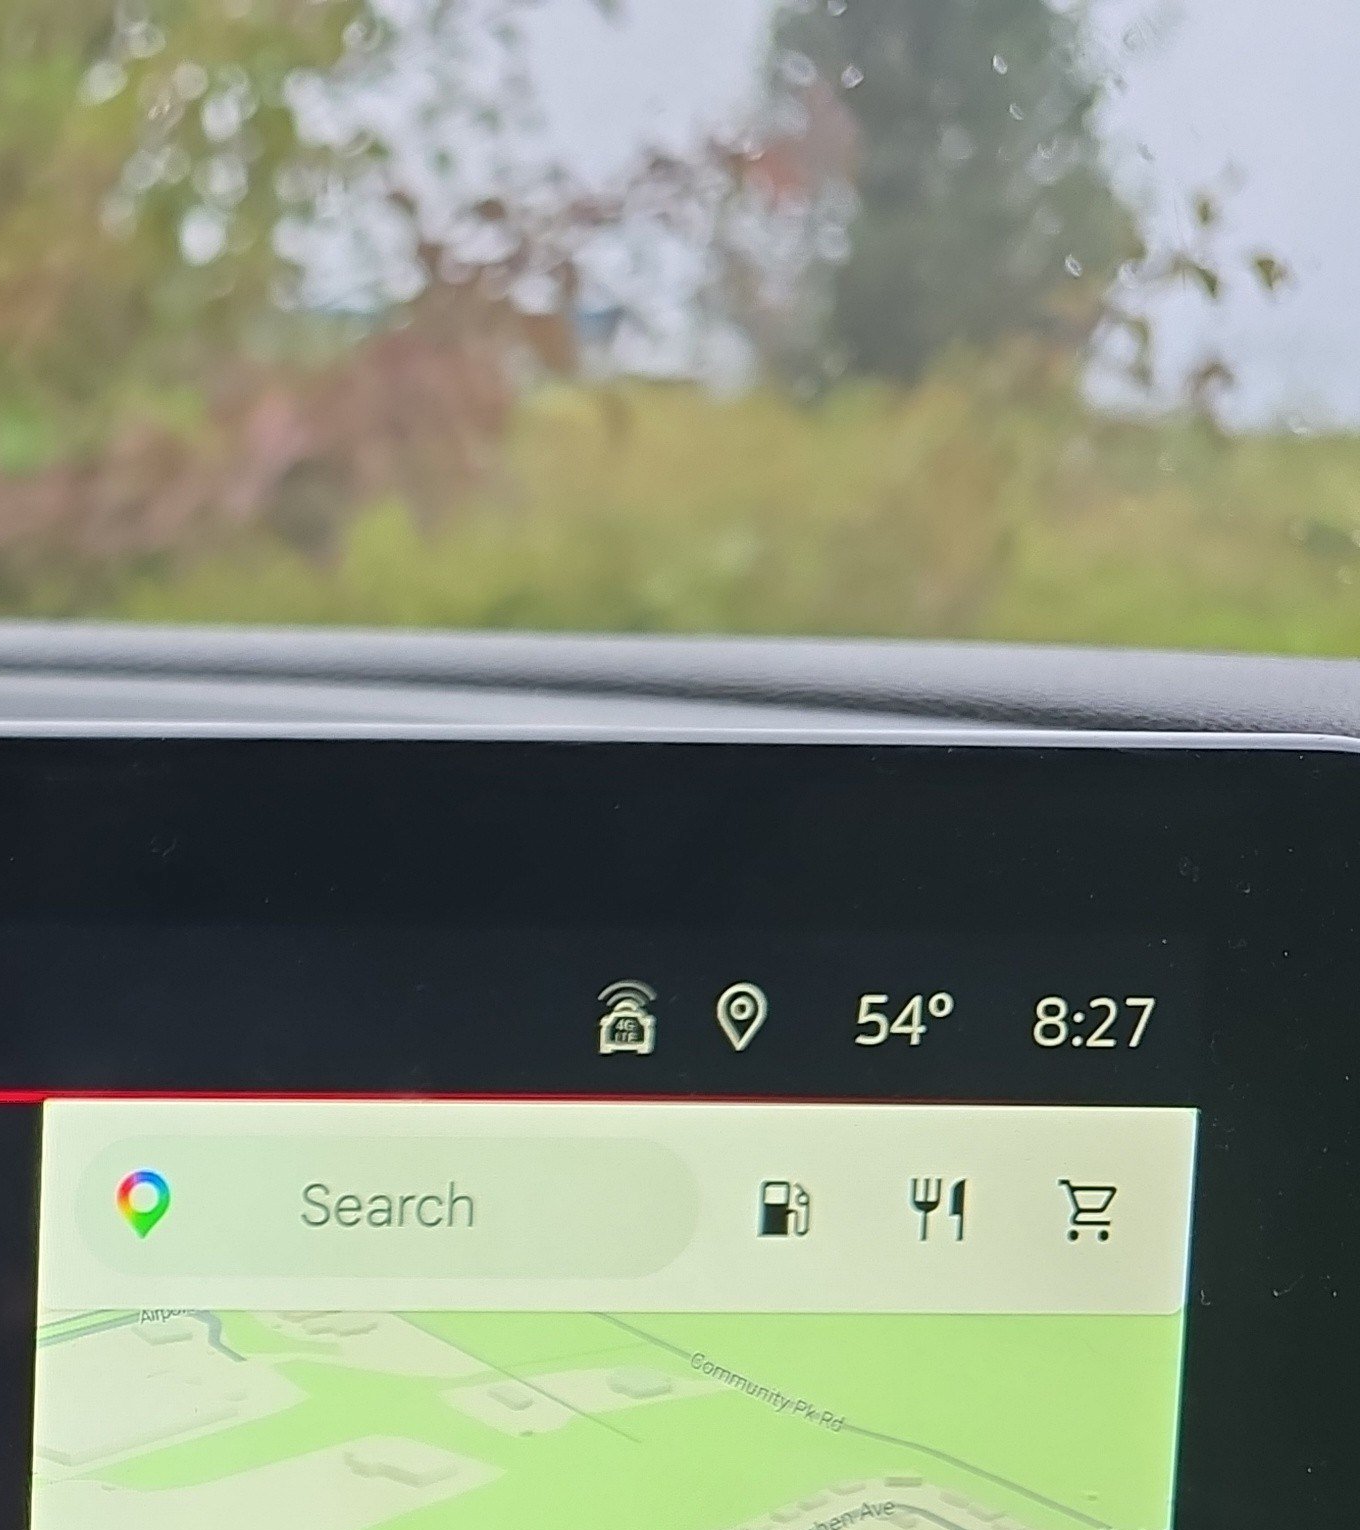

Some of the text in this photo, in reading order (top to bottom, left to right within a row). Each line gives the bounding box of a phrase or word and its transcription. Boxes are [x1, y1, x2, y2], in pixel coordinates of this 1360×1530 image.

[1033, 996, 1156, 1048] 8:27
[301, 1181, 474, 1228] Search
[690, 1352, 844, 1432] Community Pk Rd
[857, 1500, 896, 1521] Ave
